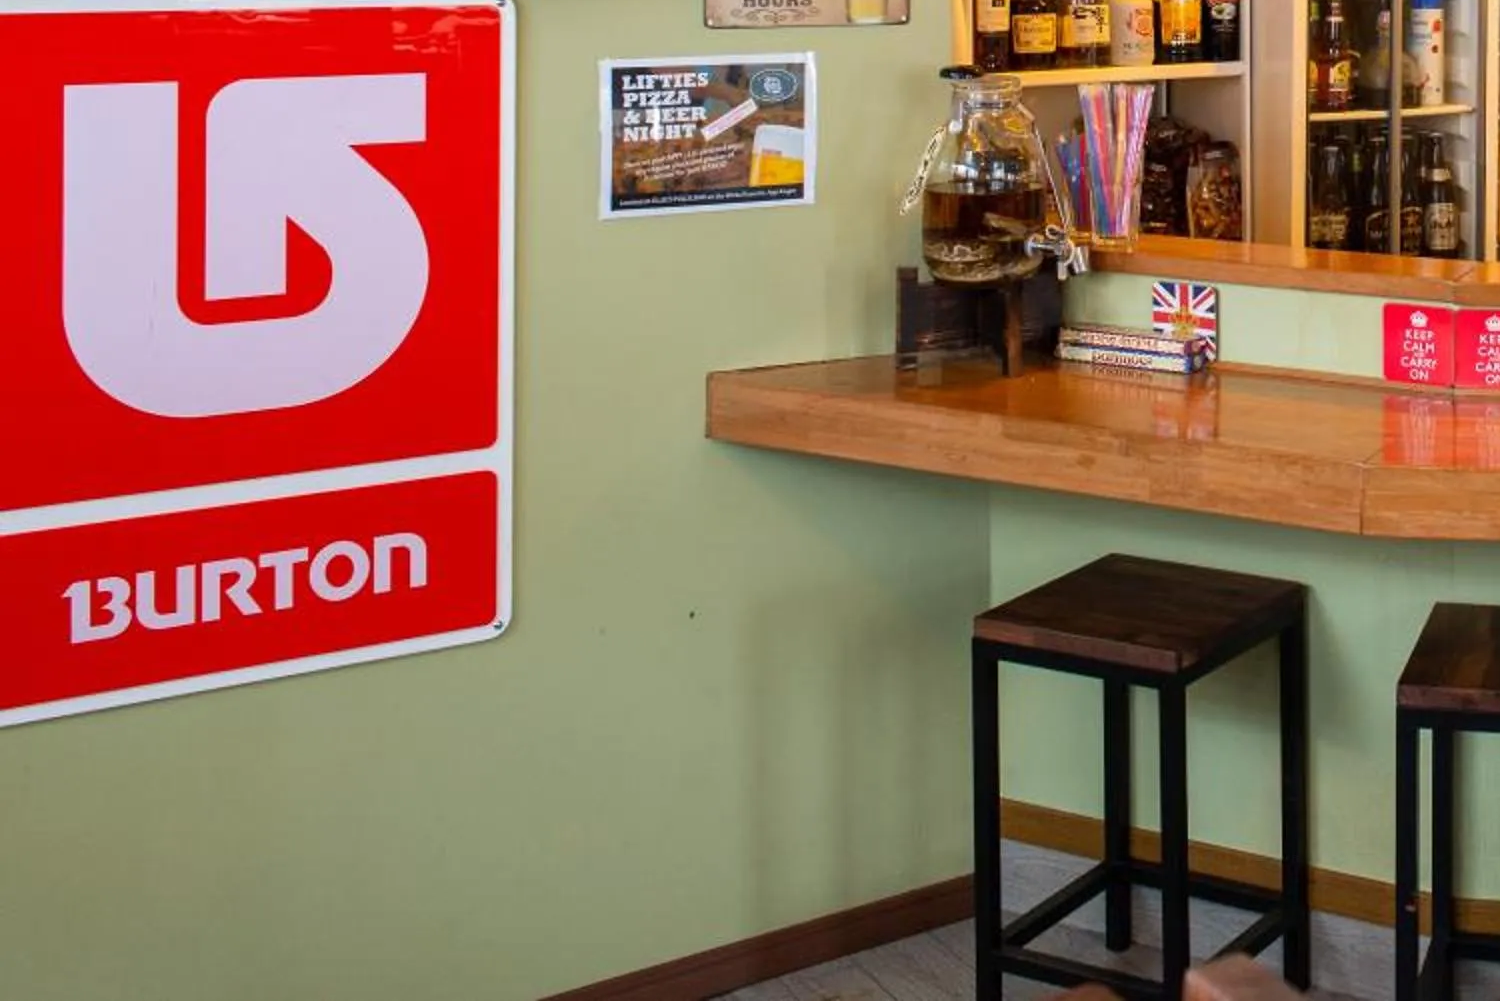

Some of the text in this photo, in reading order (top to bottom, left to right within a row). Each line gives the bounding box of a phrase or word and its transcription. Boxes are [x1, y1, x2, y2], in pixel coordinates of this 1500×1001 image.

[621, 72, 710, 90] LIFTIES
[622, 90, 691, 108] PIZZA
[623, 106, 708, 125] & BEER
[623, 123, 698, 142] NIGHT
[1404, 329, 1434, 341] KEEP
[1403, 341, 1435, 353] CALM
[1400, 357, 1438, 370] CARRY
[1409, 369, 1429, 381] ON
[61, 531, 429, 645] BURTON
